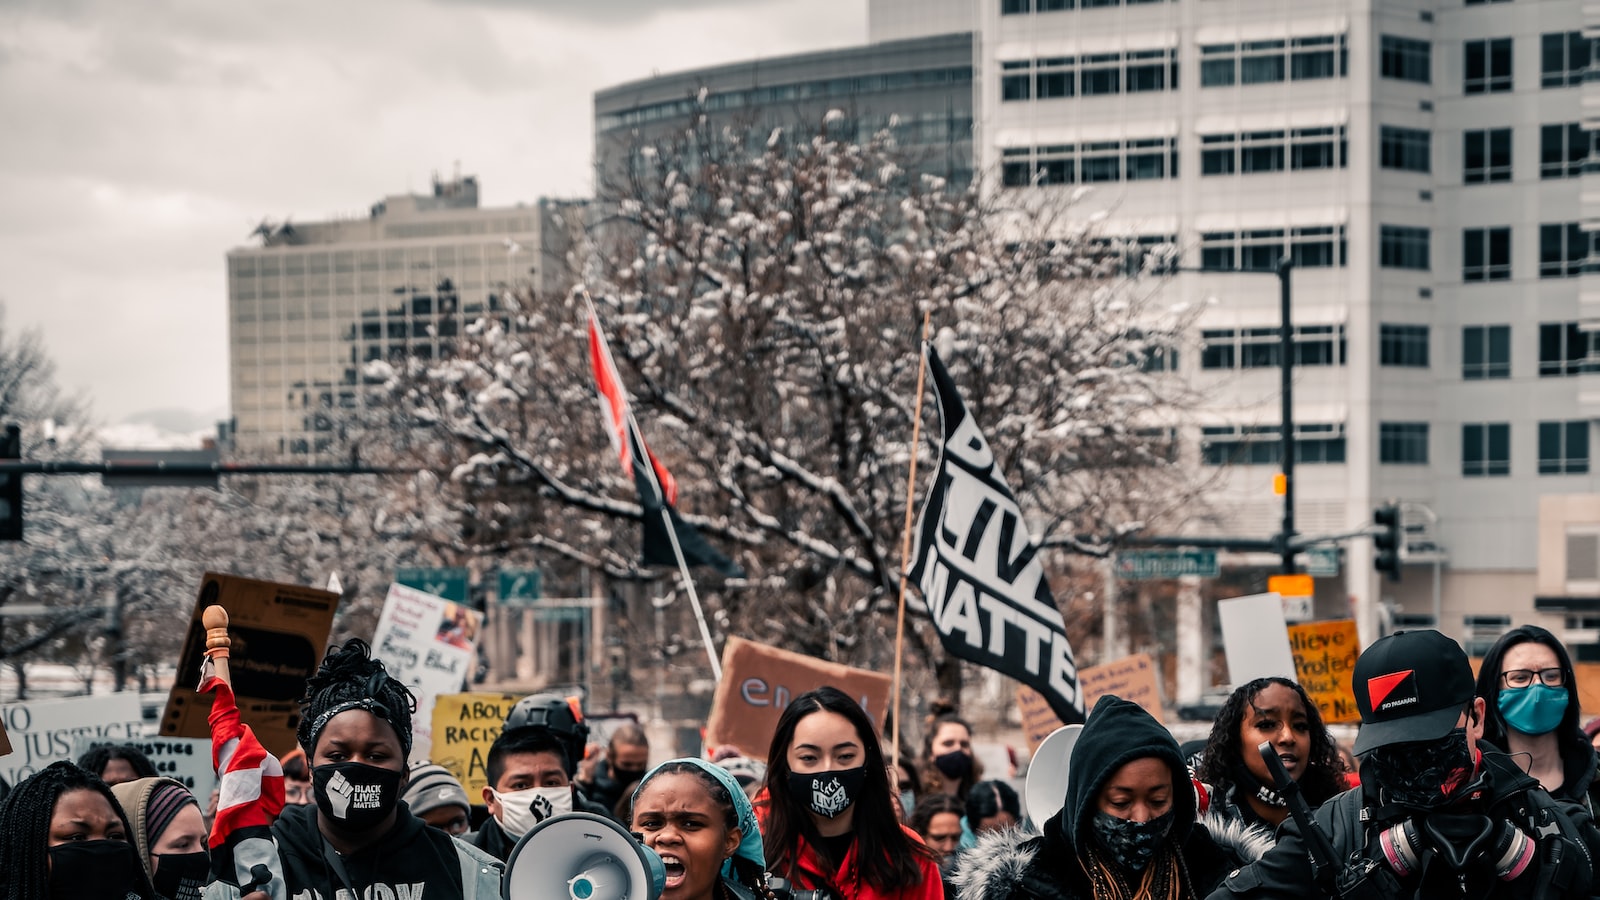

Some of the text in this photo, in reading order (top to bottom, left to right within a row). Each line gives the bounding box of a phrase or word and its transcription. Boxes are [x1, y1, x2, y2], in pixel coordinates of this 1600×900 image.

[459, 701, 512, 721] ABOL
[445, 725, 505, 745] RACIS
[354, 784, 382, 793] BLACK
[812, 777, 841, 796] BLACK
[352, 801, 381, 809] MATTER
[353, 792, 380, 802] LIVES
[815, 788, 846, 809] LIVES
[811, 797, 850, 818] MATTER
